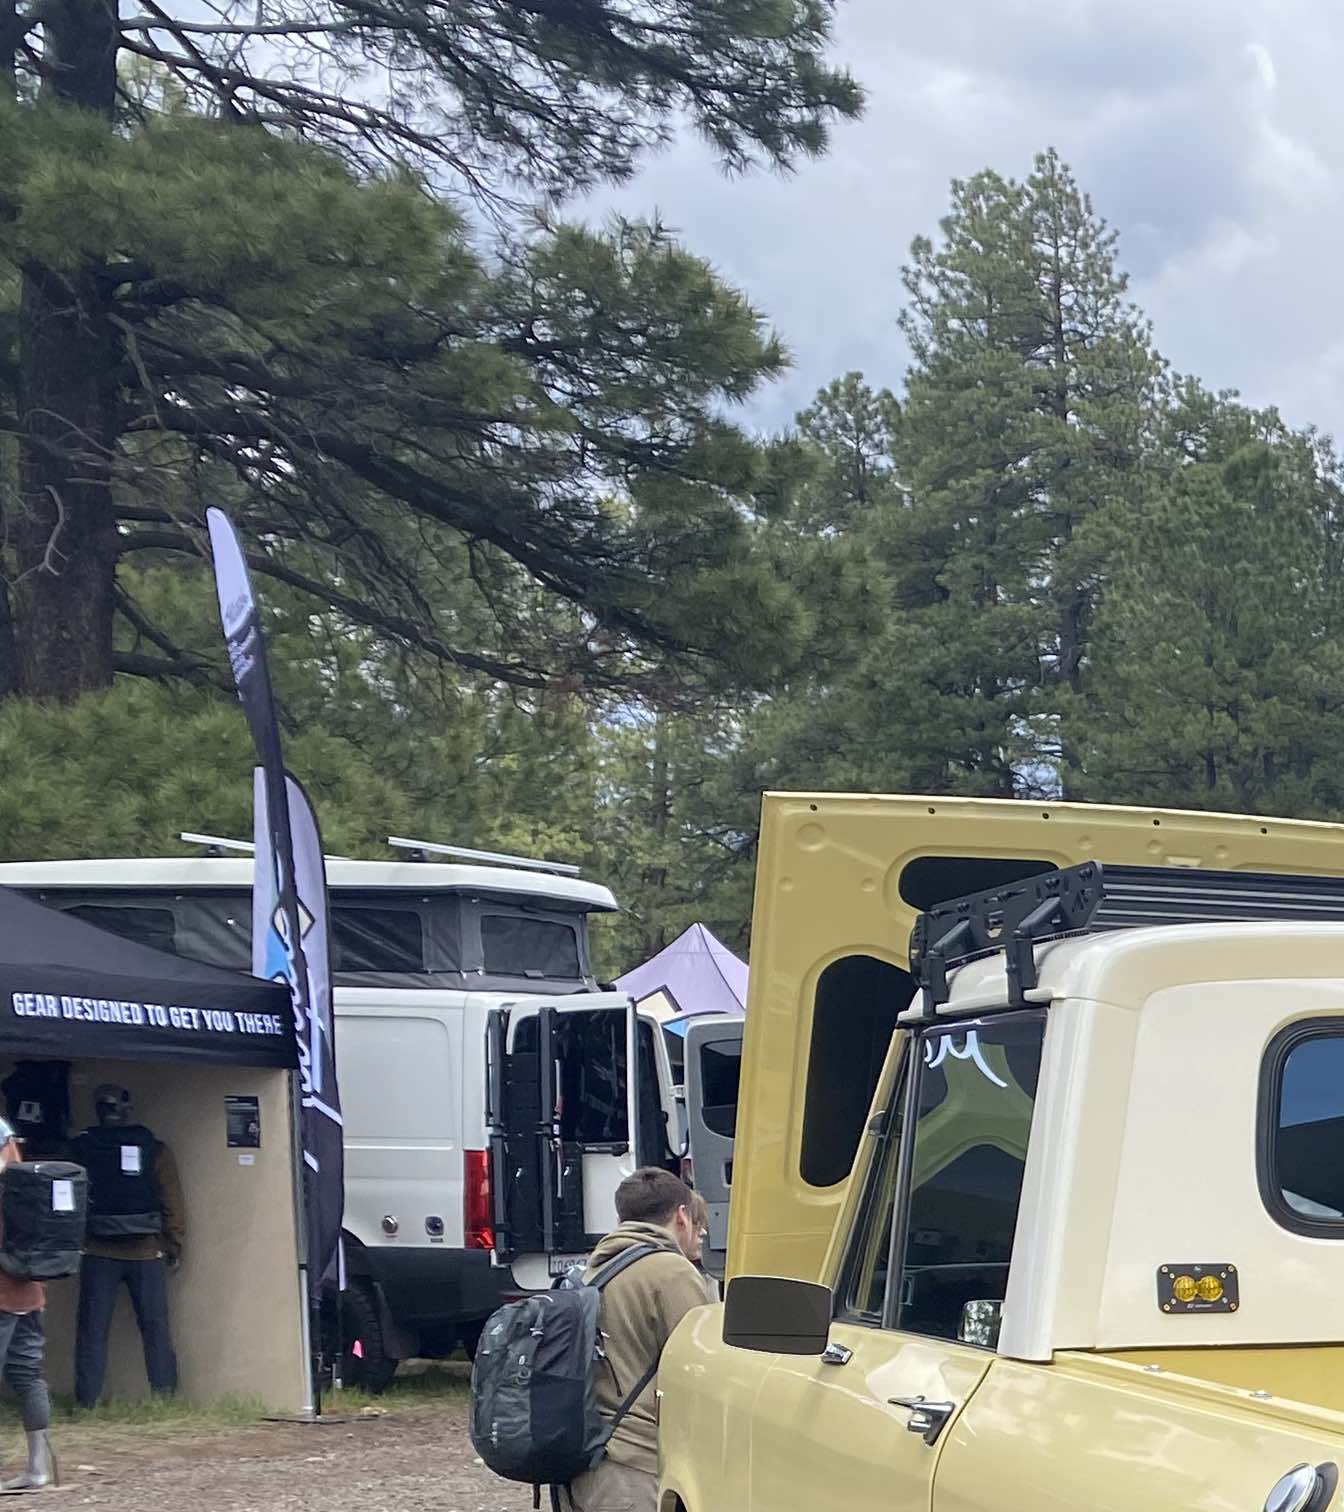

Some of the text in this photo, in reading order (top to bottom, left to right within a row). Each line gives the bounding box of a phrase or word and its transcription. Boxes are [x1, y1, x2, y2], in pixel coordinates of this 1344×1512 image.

[12, 993, 283, 1035] GEAR DESIGNED TO GET YOU THERE
